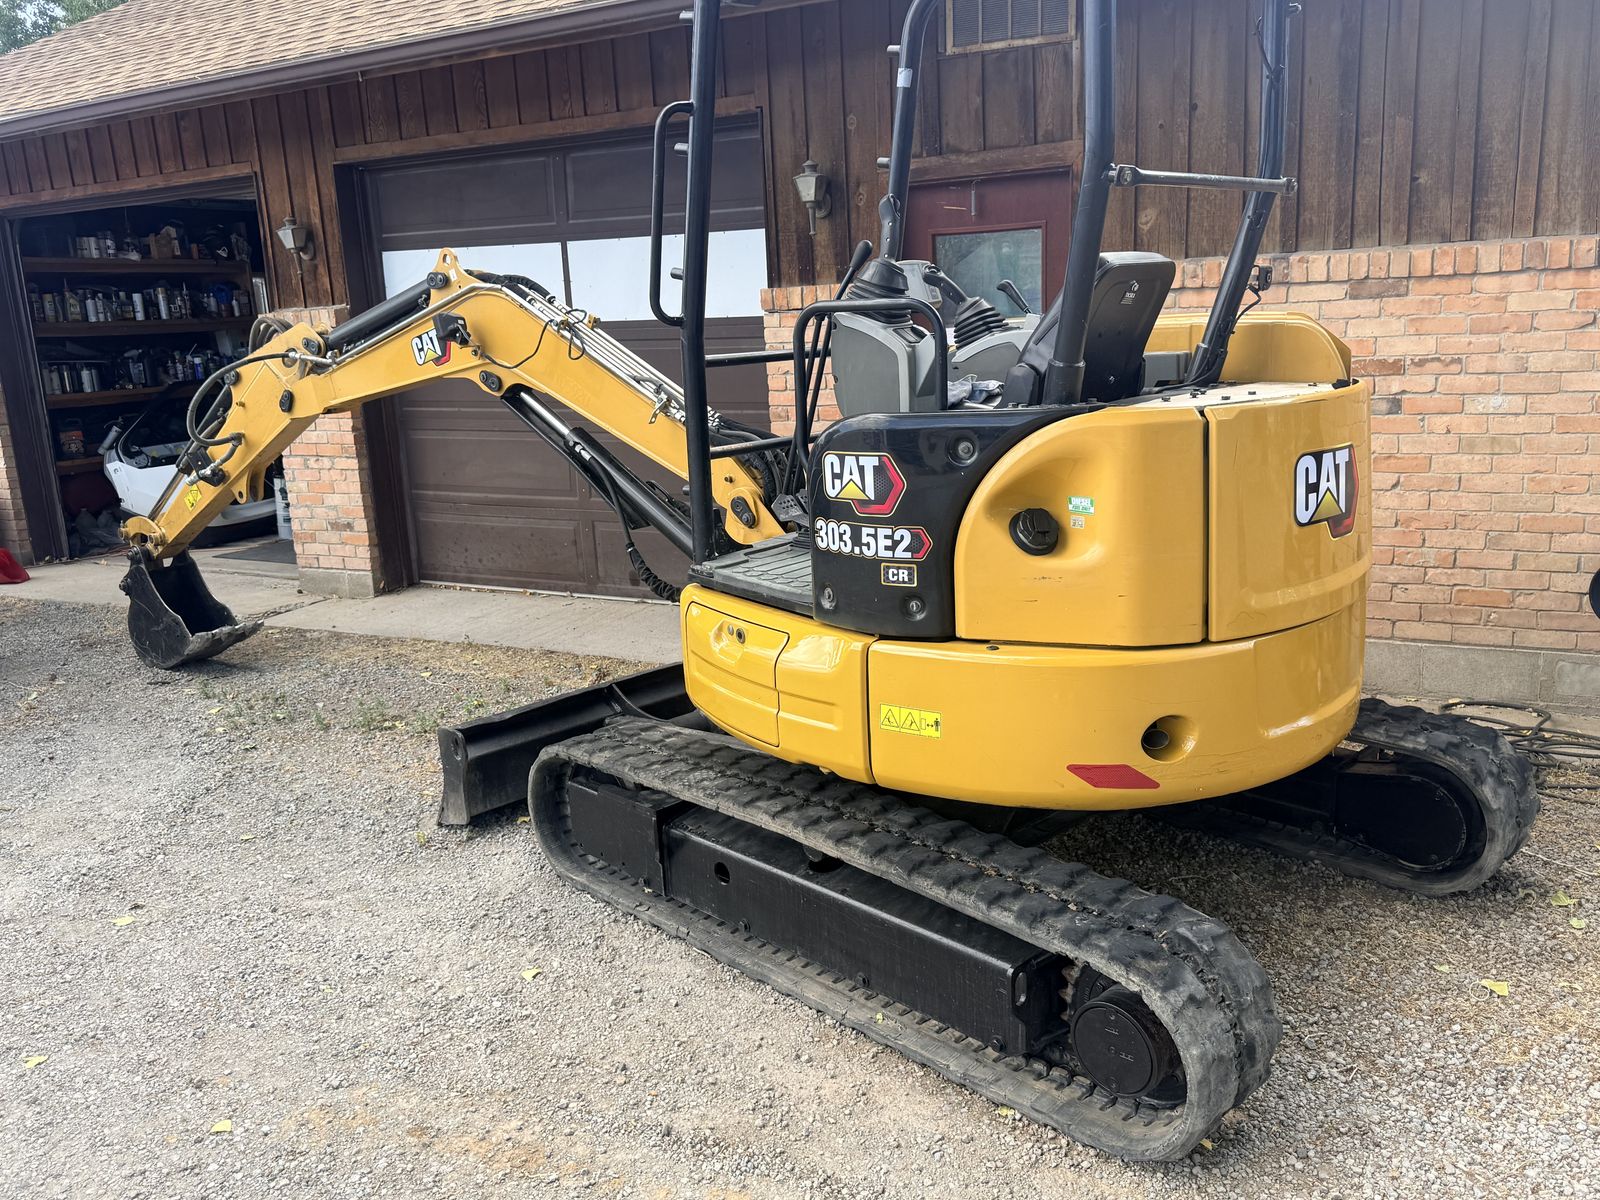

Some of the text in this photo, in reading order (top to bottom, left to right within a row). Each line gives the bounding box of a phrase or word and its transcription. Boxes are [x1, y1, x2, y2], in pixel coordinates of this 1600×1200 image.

[411, 329, 442, 366] CAT
[824, 453, 879, 500] CAT
[1296, 447, 1349, 524] CAT
[815, 519, 912, 558] 303.5E2
[888, 568, 909, 581] CR
